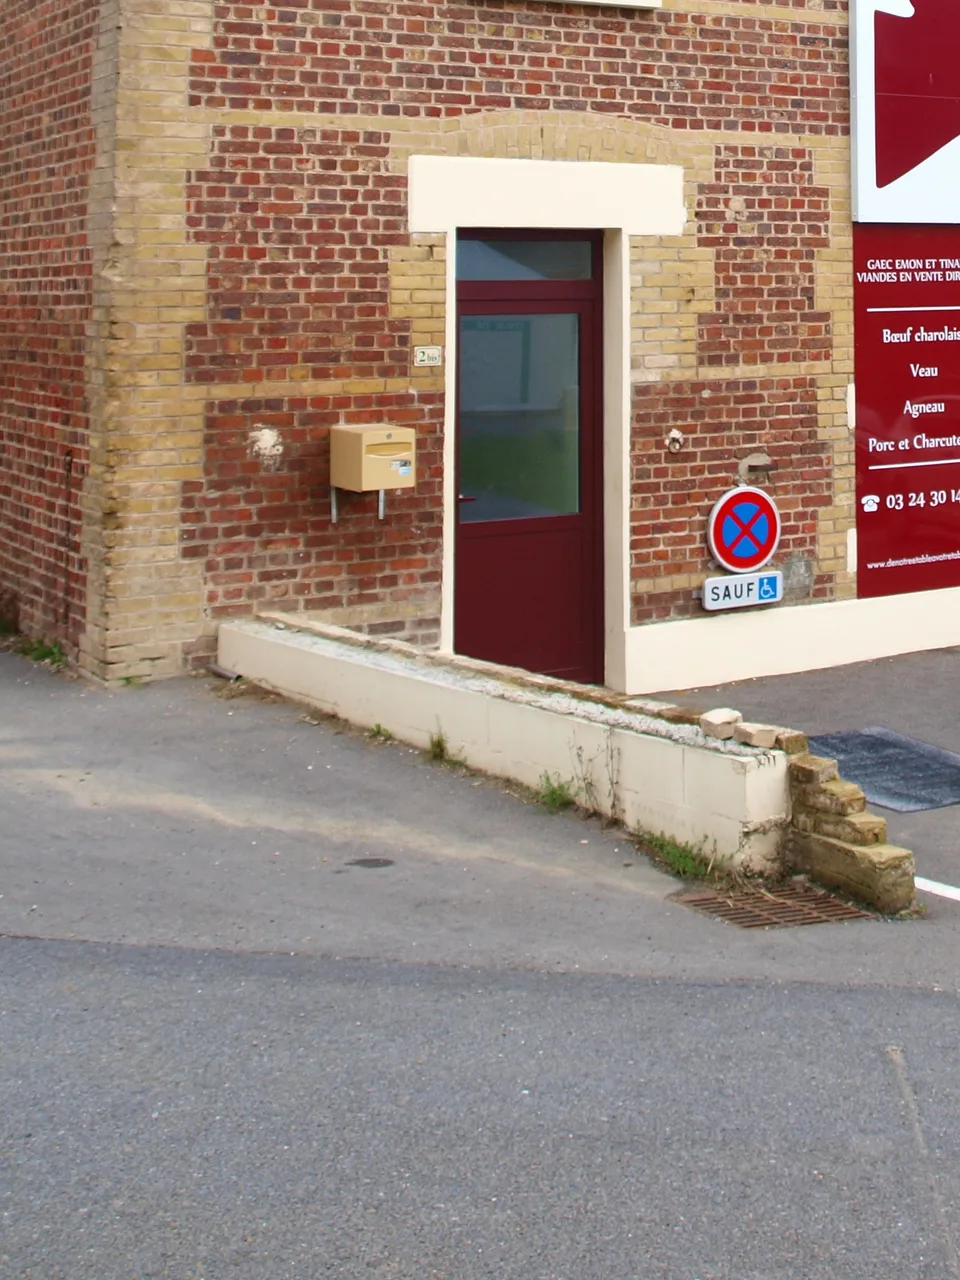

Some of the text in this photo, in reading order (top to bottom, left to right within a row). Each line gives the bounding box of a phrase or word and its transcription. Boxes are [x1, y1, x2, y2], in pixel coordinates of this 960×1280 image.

[867, 258, 893, 270] GAEC
[895, 258, 923, 269] EMON
[925, 258, 937, 269] ET
[857, 272, 897, 282] VIANDES
[900, 272, 912, 282] EN
[915, 271, 943, 281] VENTE
[883, 327, 913, 343] Bœuf
[419, 351, 425, 362] 2
[910, 364, 938, 377] Veau
[904, 400, 944, 418] Agneau
[869, 438, 894, 452] Porc
[898, 438, 909, 450] et
[886, 494, 904, 509] 03
[909, 492, 925, 507] 24
[930, 490, 946, 506] 30
[712, 583, 754, 601] SAUF
